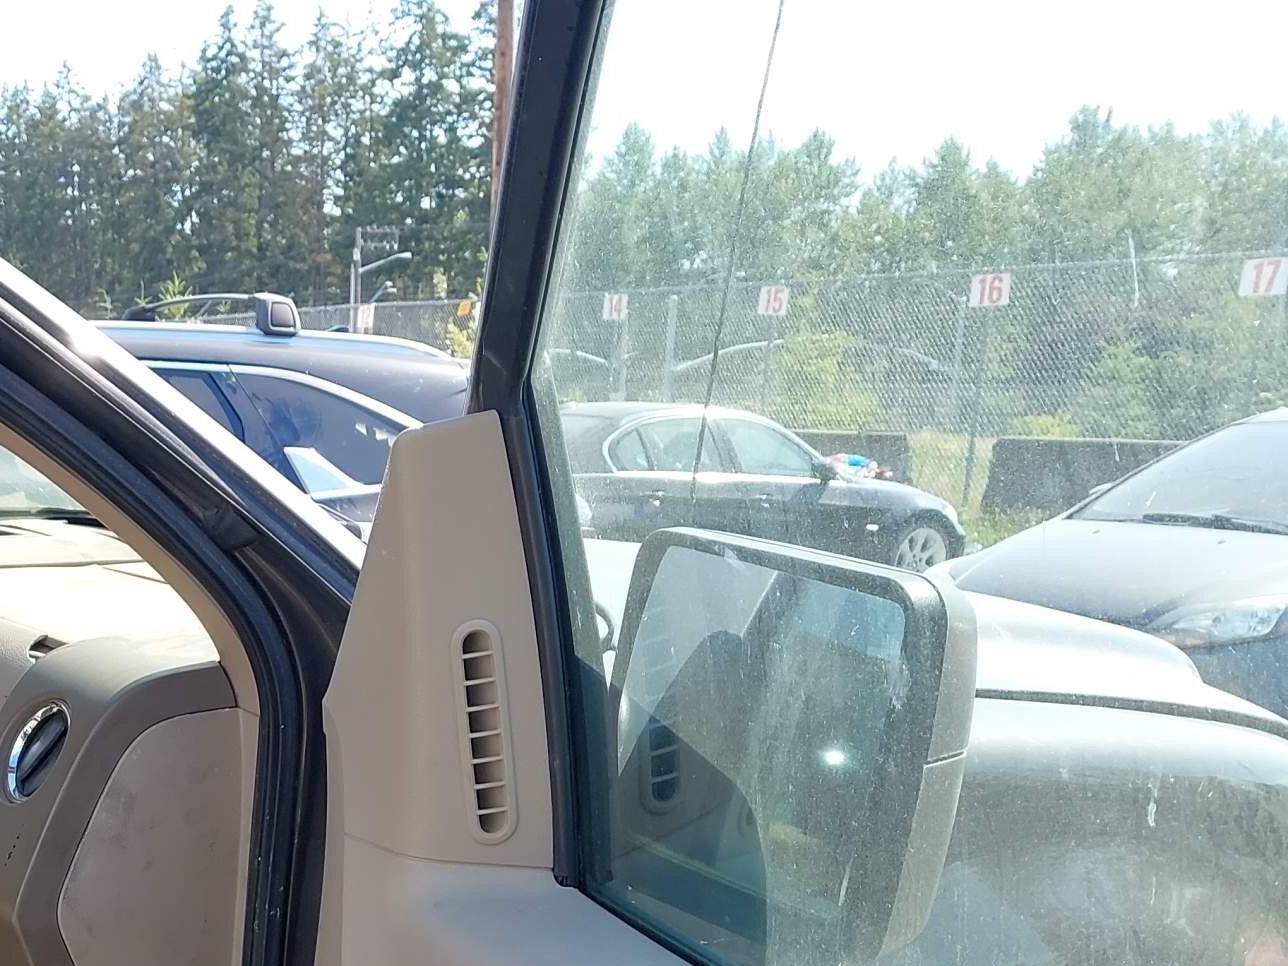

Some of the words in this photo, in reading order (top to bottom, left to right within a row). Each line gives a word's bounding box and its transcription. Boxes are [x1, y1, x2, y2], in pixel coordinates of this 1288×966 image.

[978, 275, 1003, 305] 16
[1253, 260, 1282, 293] 17
[608, 294, 623, 319] 14
[765, 287, 785, 313] 15
